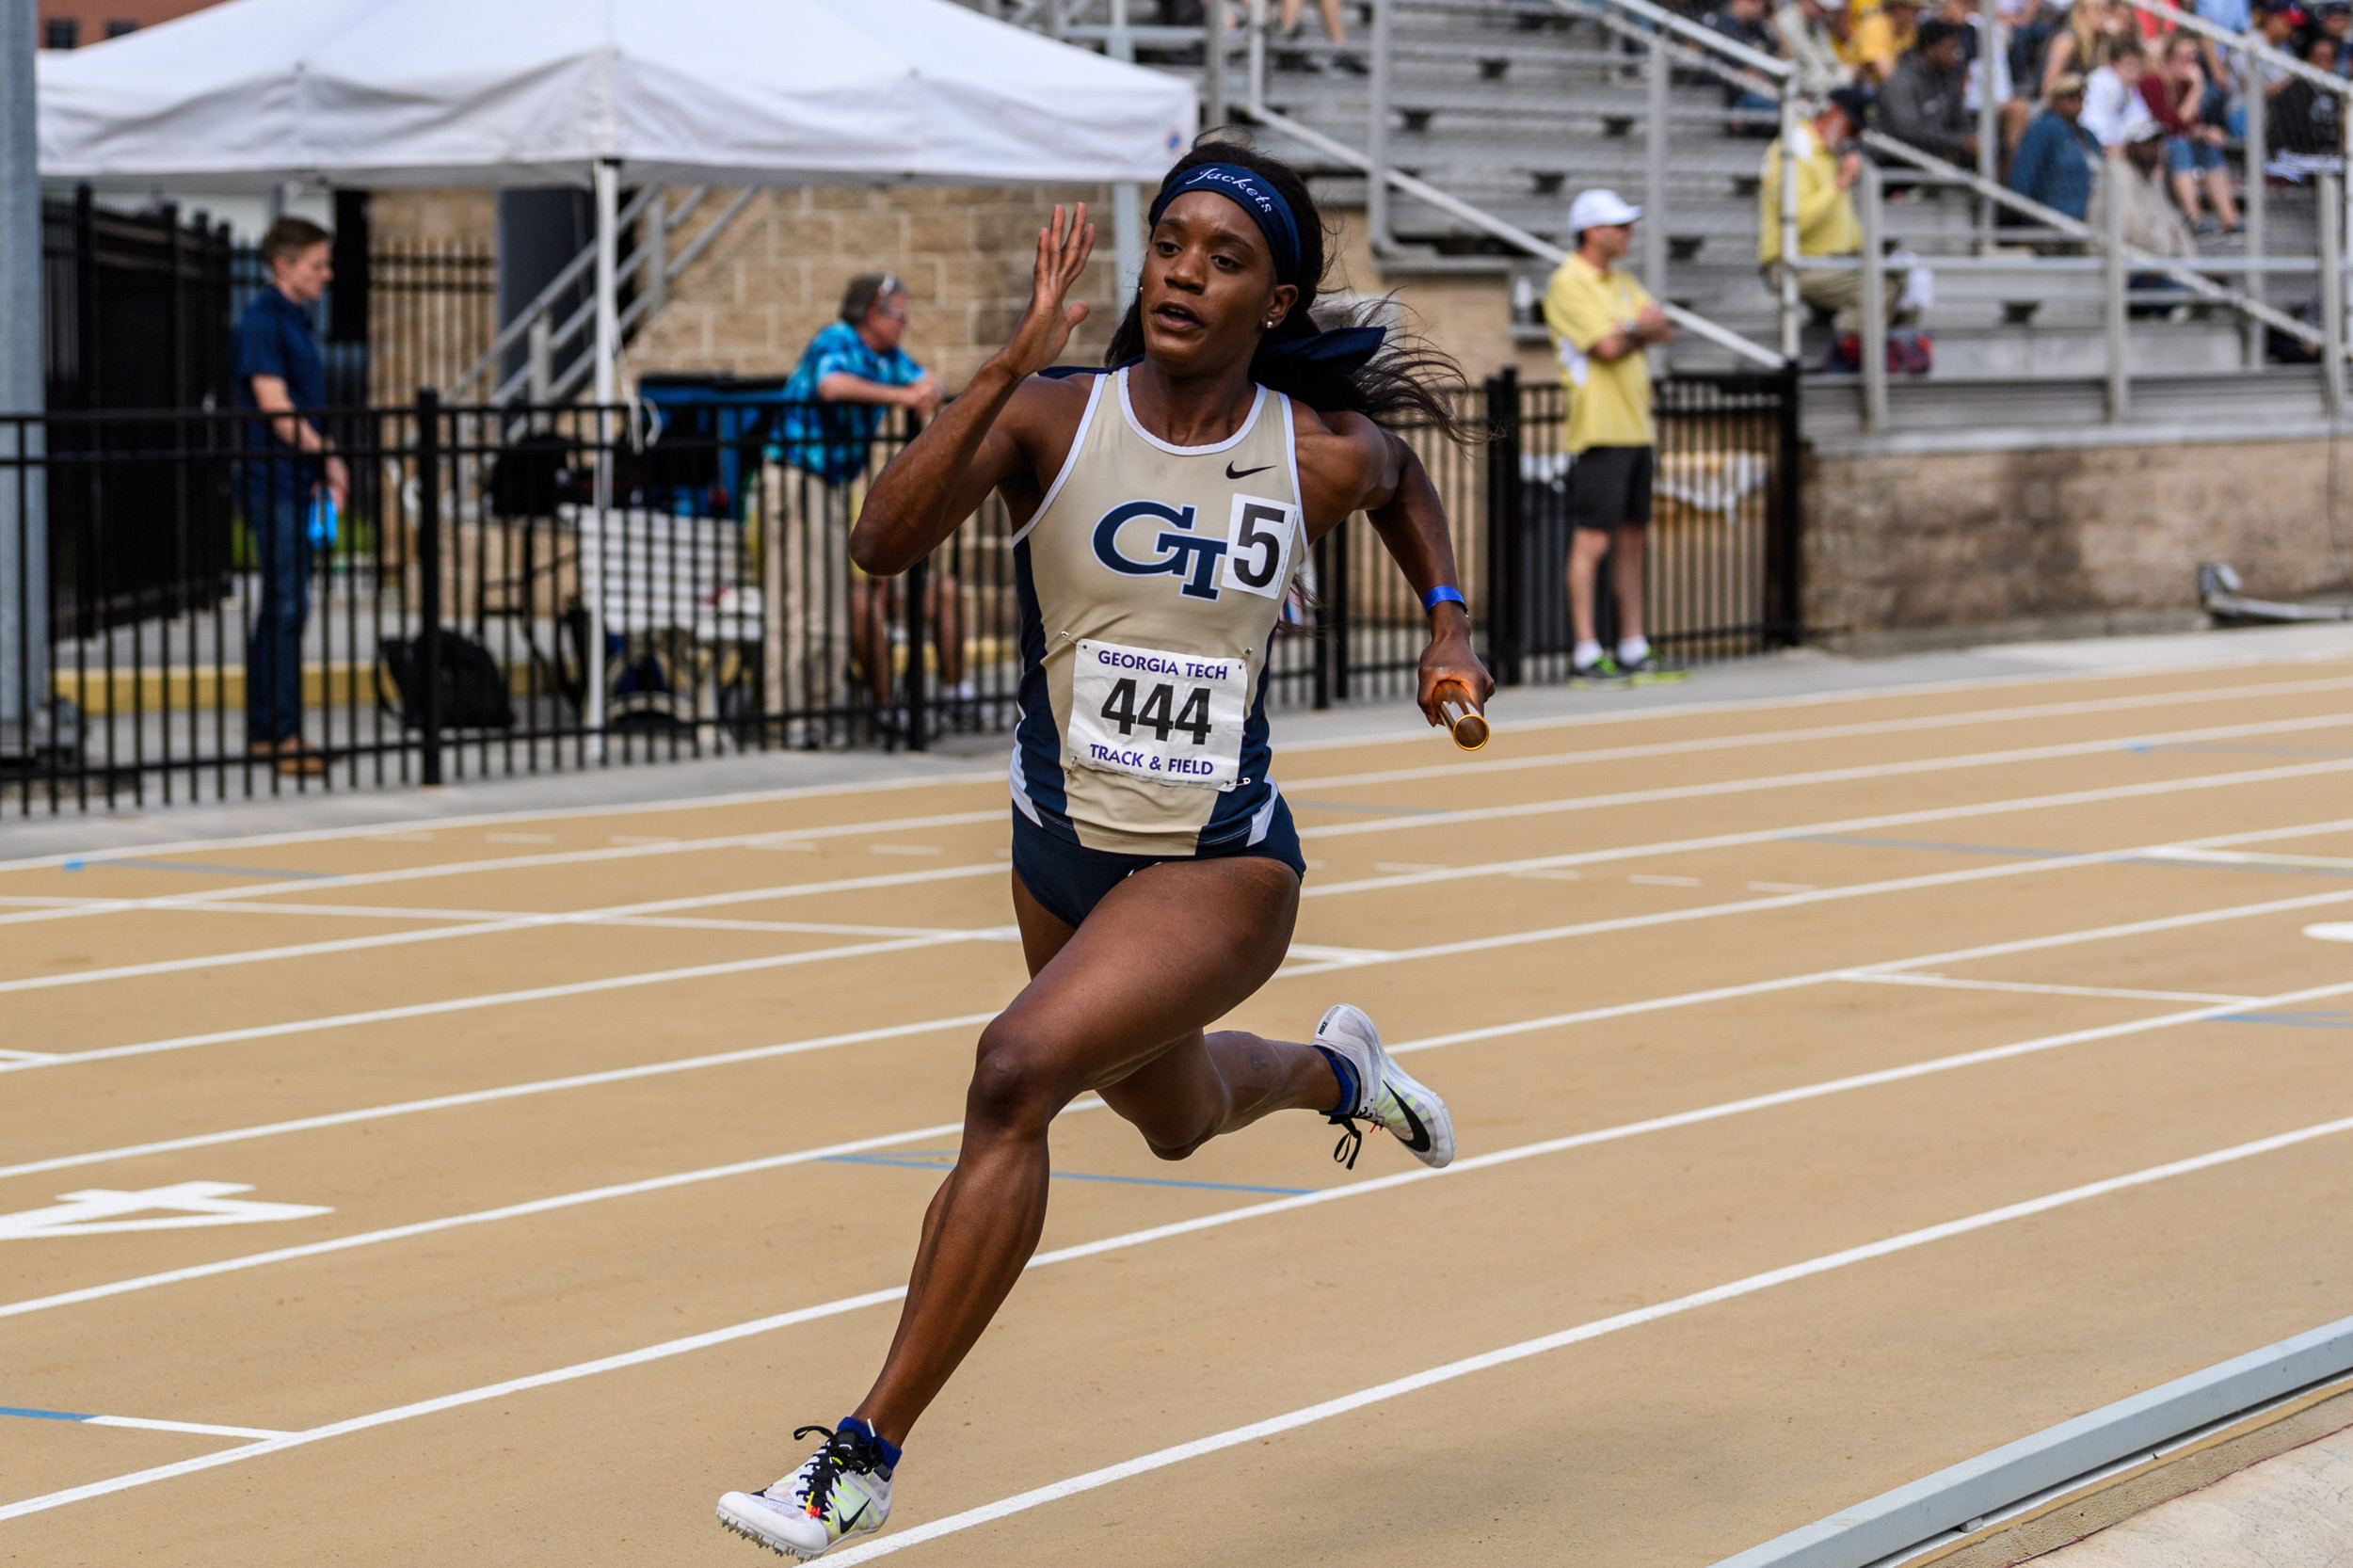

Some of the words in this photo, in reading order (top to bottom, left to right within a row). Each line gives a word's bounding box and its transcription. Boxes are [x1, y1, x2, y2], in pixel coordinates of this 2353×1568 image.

[1185, 168, 1272, 213] Jackets
[1091, 499, 1228, 602] GT
[1233, 503, 1287, 588] 5
[1097, 649, 1179, 676] GEORGIA
[1185, 662, 1228, 680] TECH
[1100, 677, 1212, 745] 444
[1089, 744, 1144, 768] TRACK
[1148, 757, 1161, 771] &
[1167, 758, 1214, 776] FIELD
